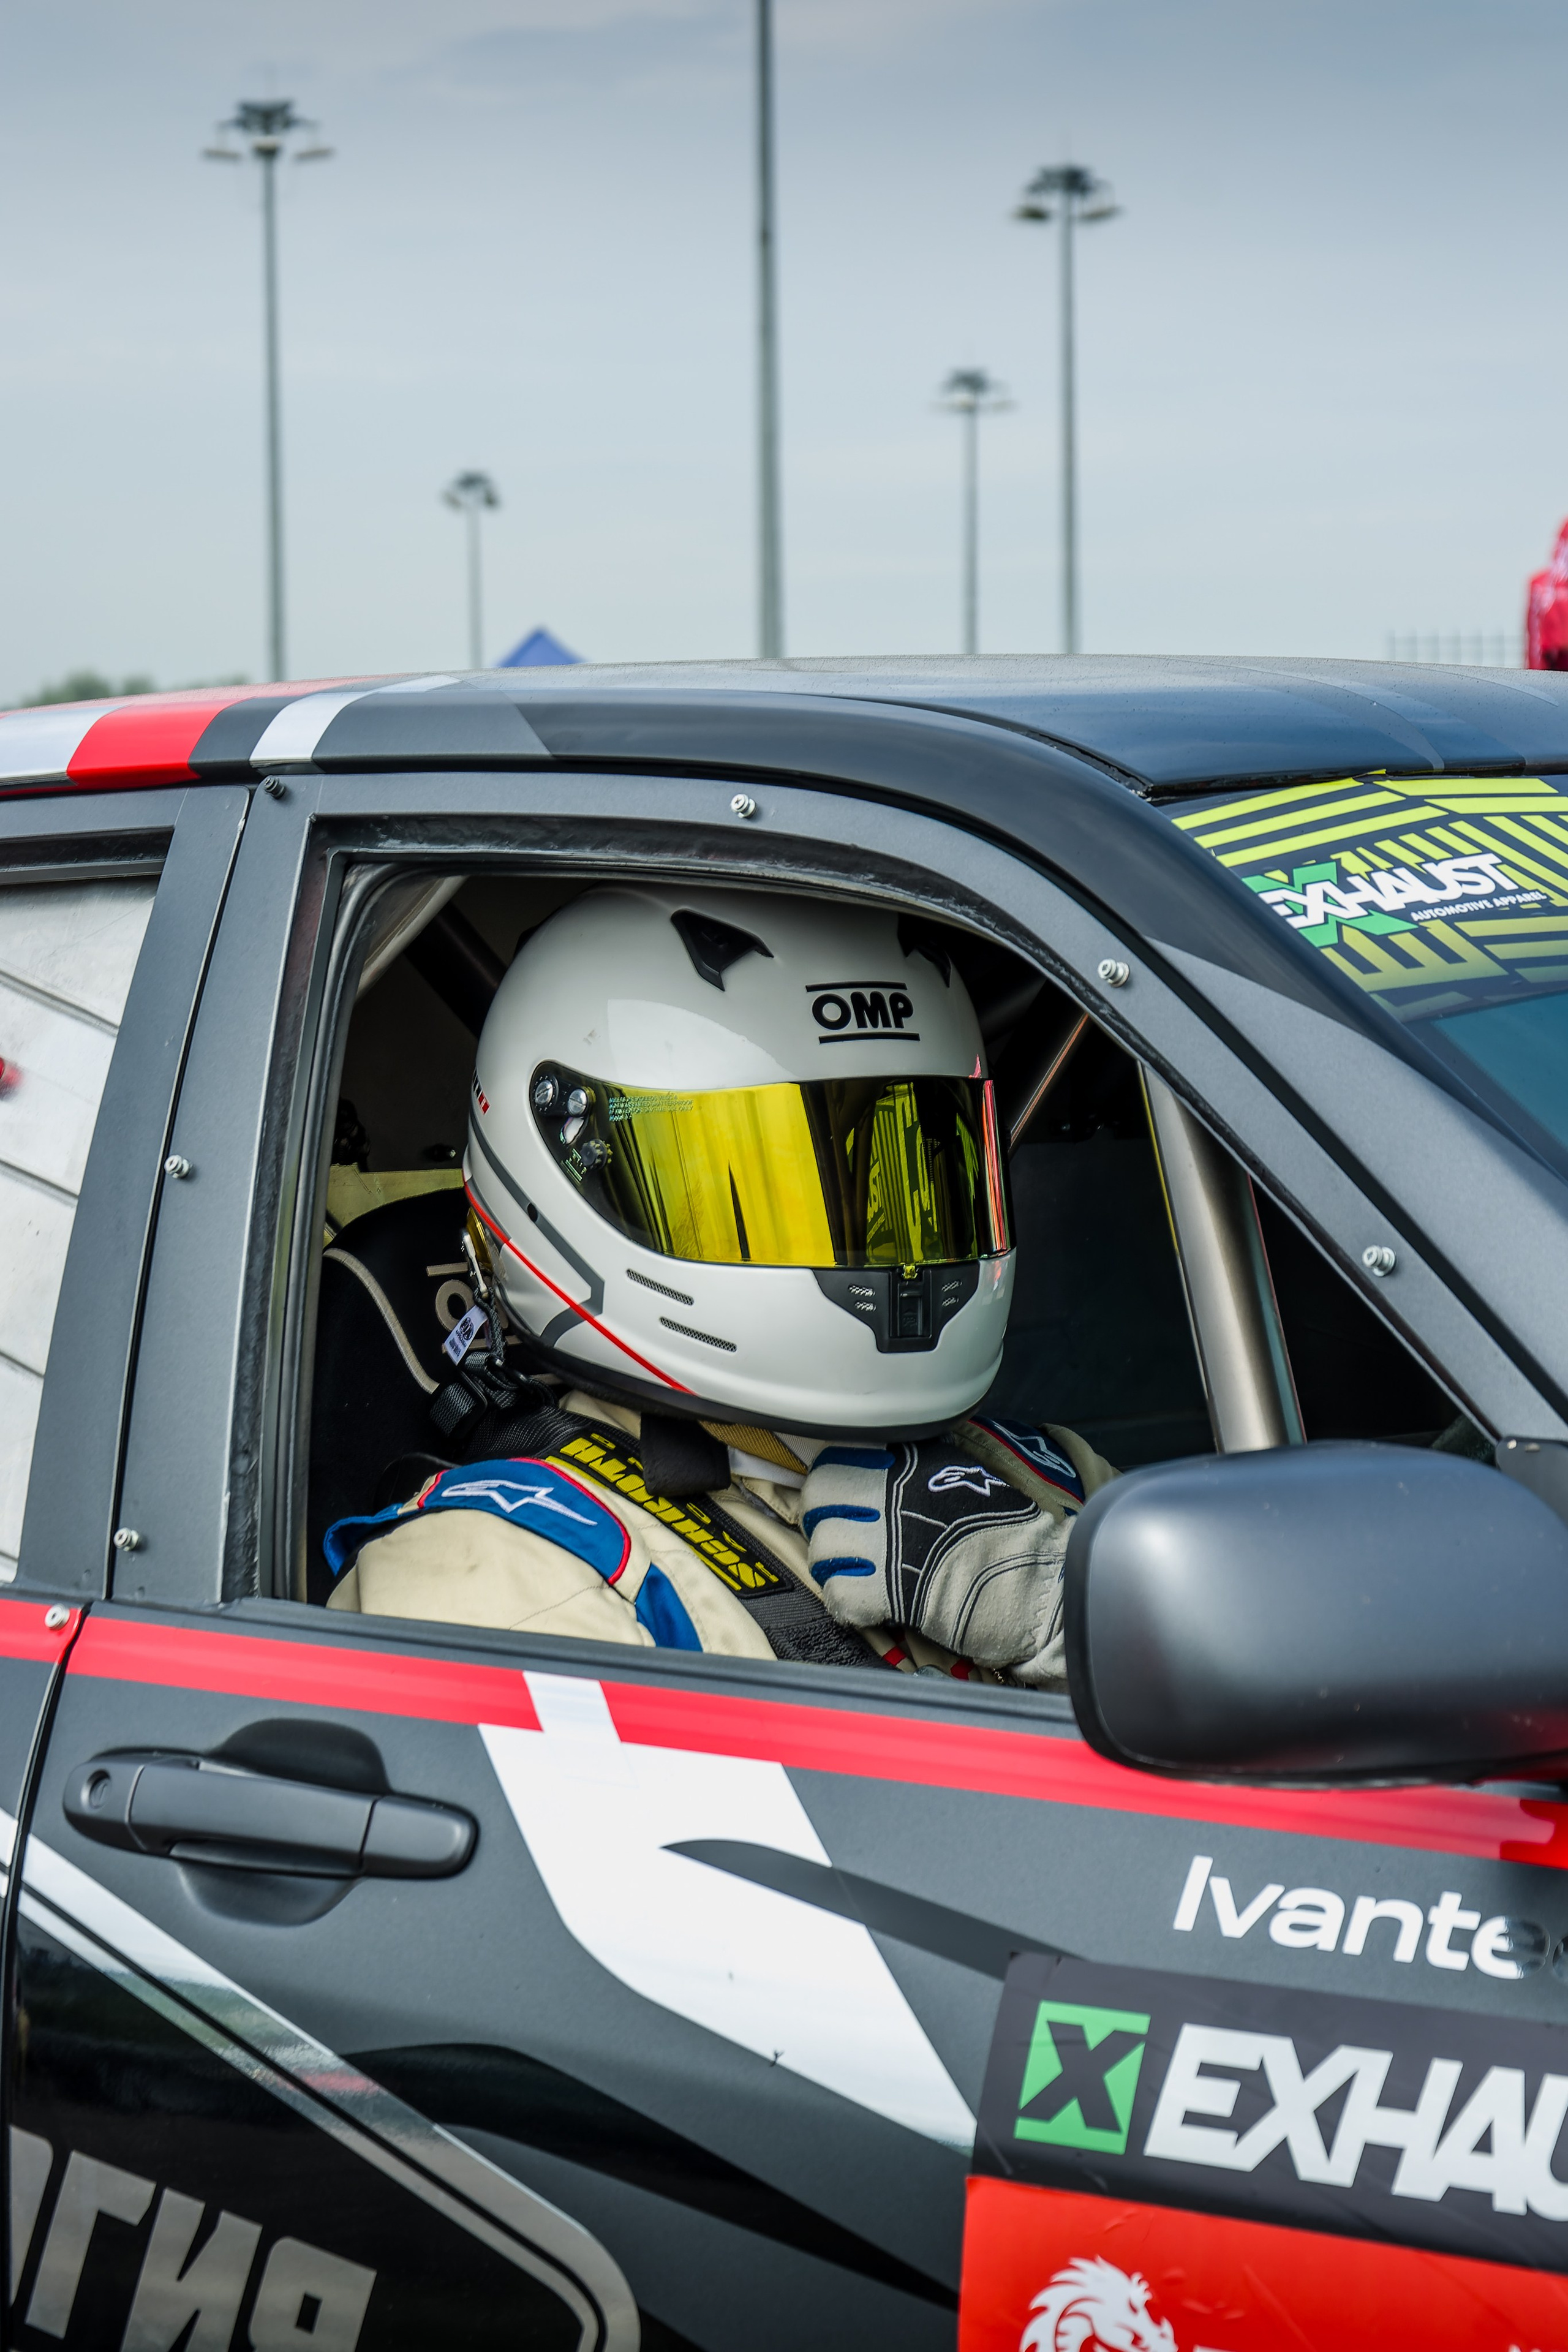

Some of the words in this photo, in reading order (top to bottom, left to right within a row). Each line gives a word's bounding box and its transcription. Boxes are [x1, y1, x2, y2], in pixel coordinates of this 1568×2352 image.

[1257, 852, 1519, 929] EXHAUST
[1410, 899, 1493, 922] AUTOMOTIVE
[1492, 891, 1548, 908] APPAREL
[812, 990, 914, 1031] OMP
[590, 1433, 779, 1583] RACNG
[1173, 1855, 1568, 1979] Ivante
[10, 2124, 377, 2352] ГИЯ
